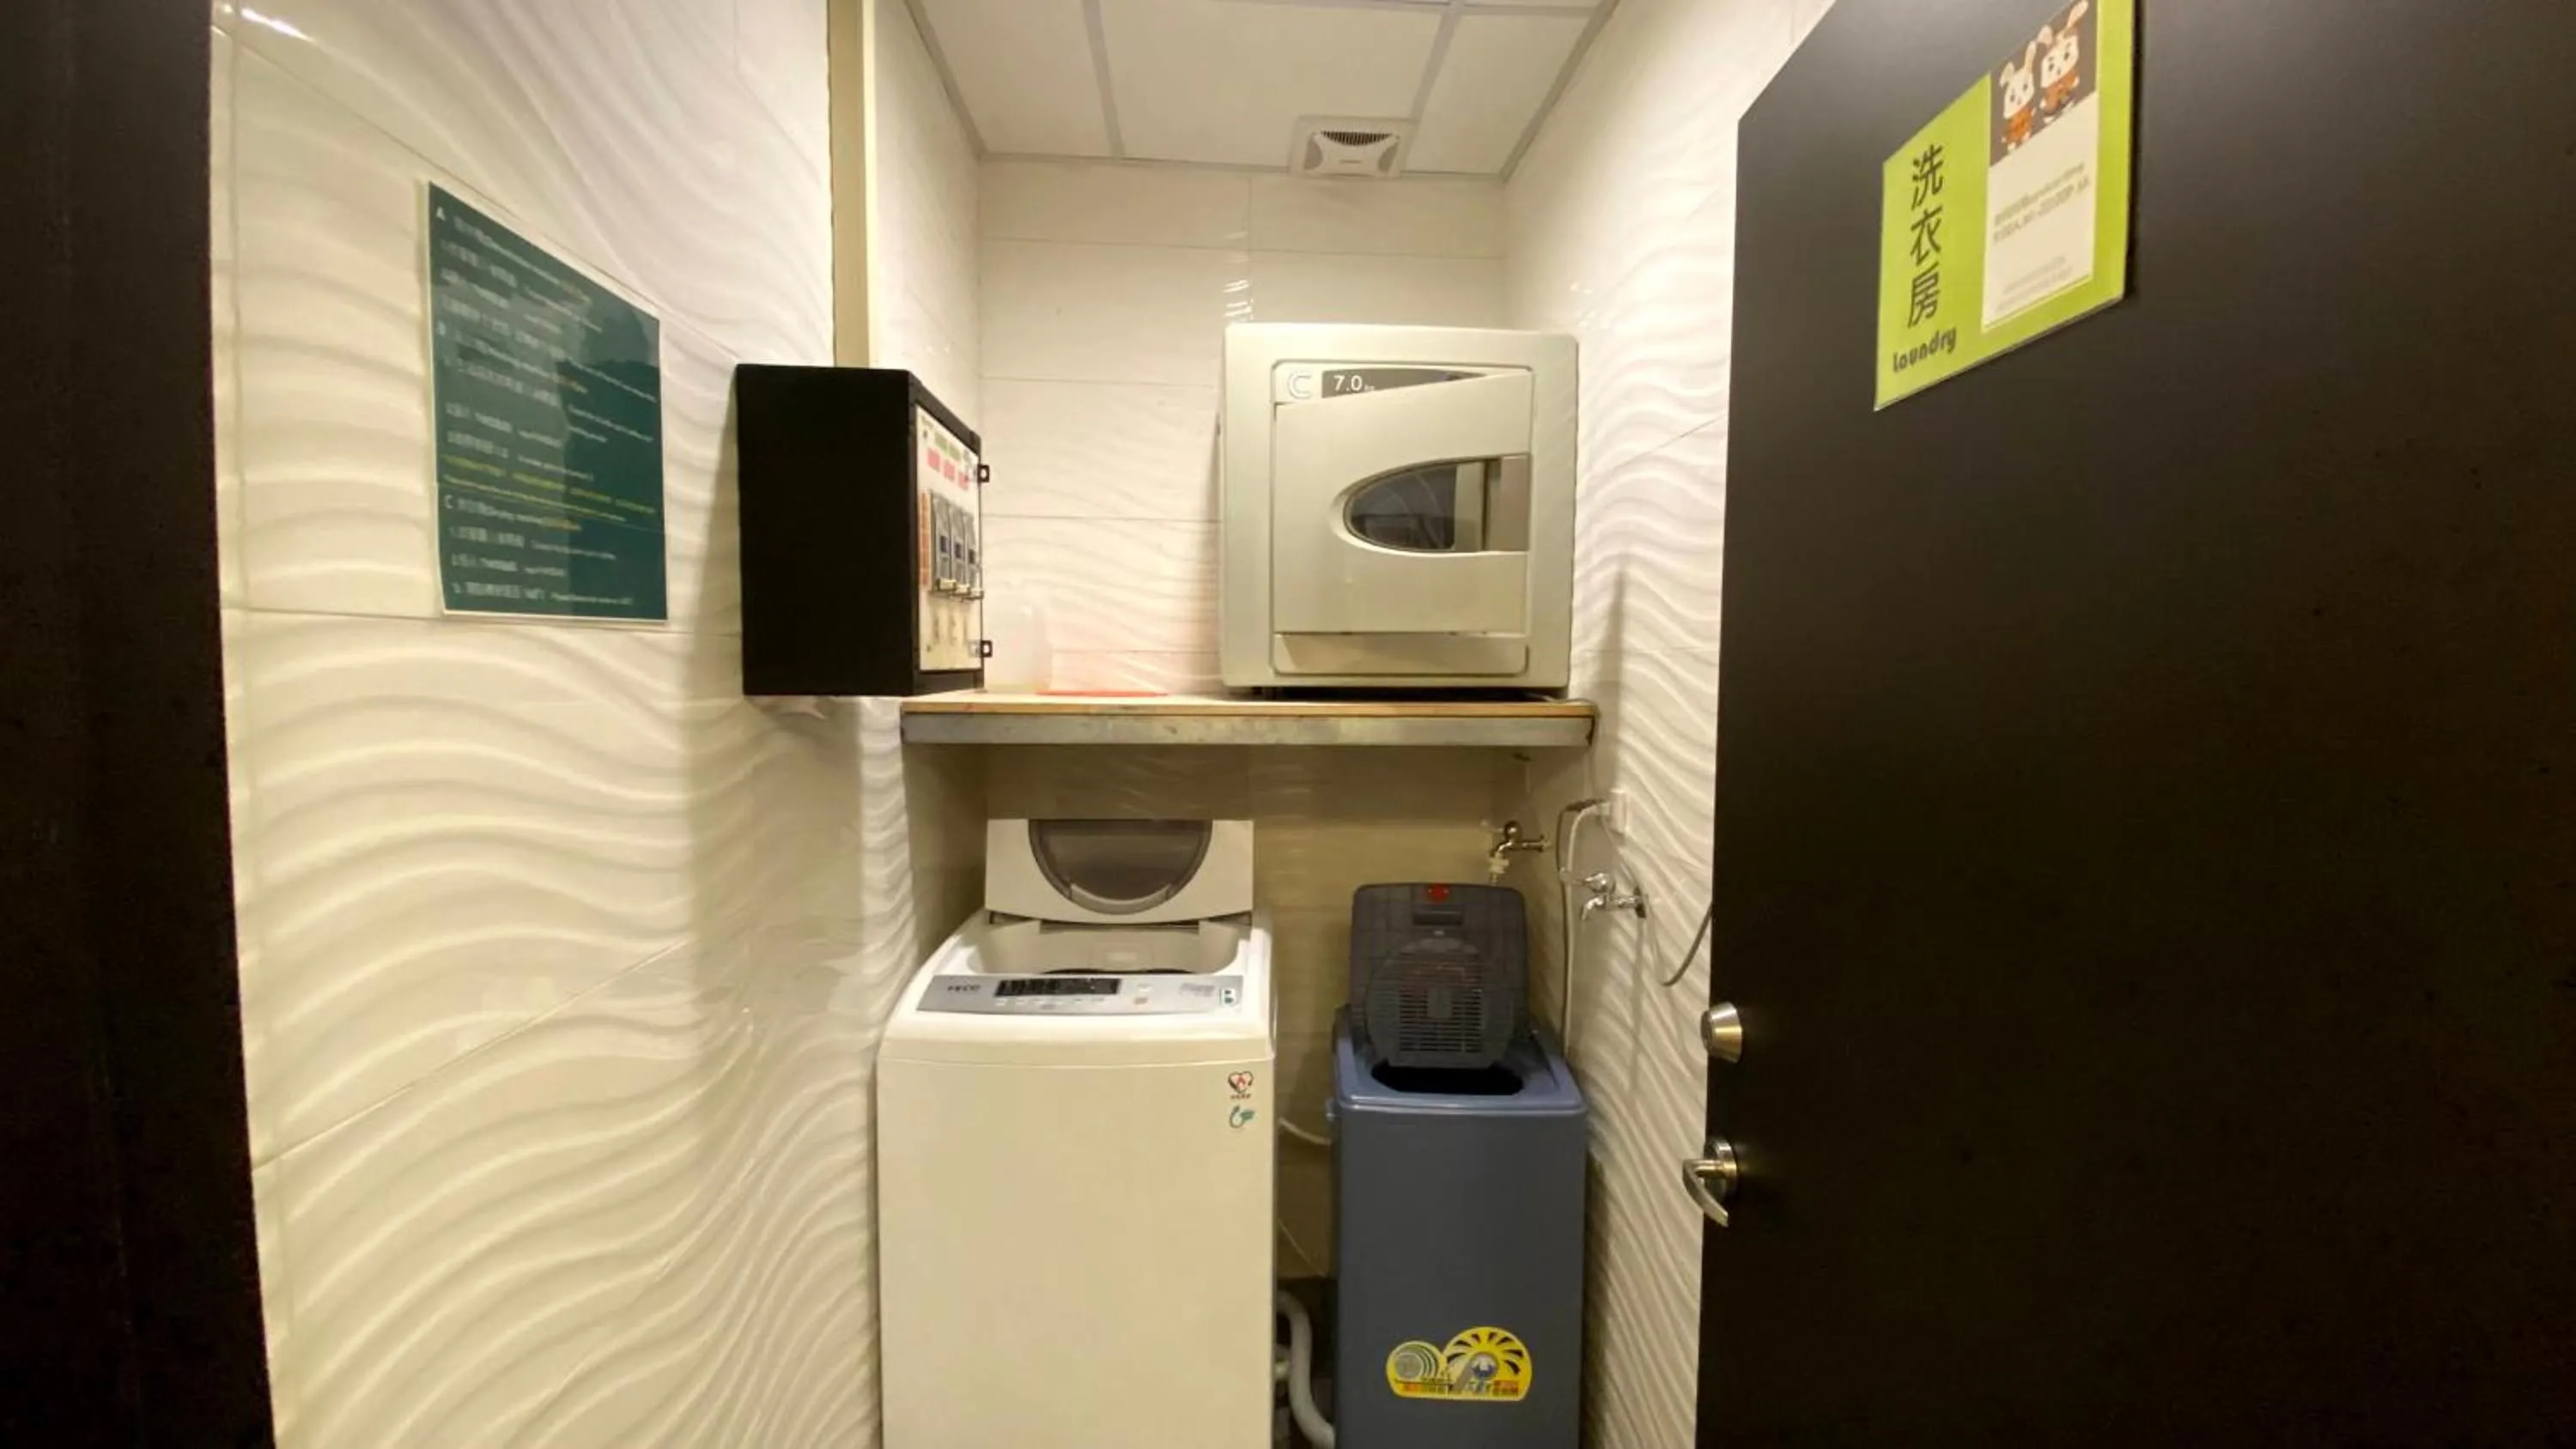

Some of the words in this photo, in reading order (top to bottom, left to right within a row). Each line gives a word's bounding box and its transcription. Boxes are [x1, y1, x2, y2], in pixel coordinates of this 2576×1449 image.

[1908, 143, 1944, 329] 洗衣房
[1334, 374, 1363, 392] 7.0
